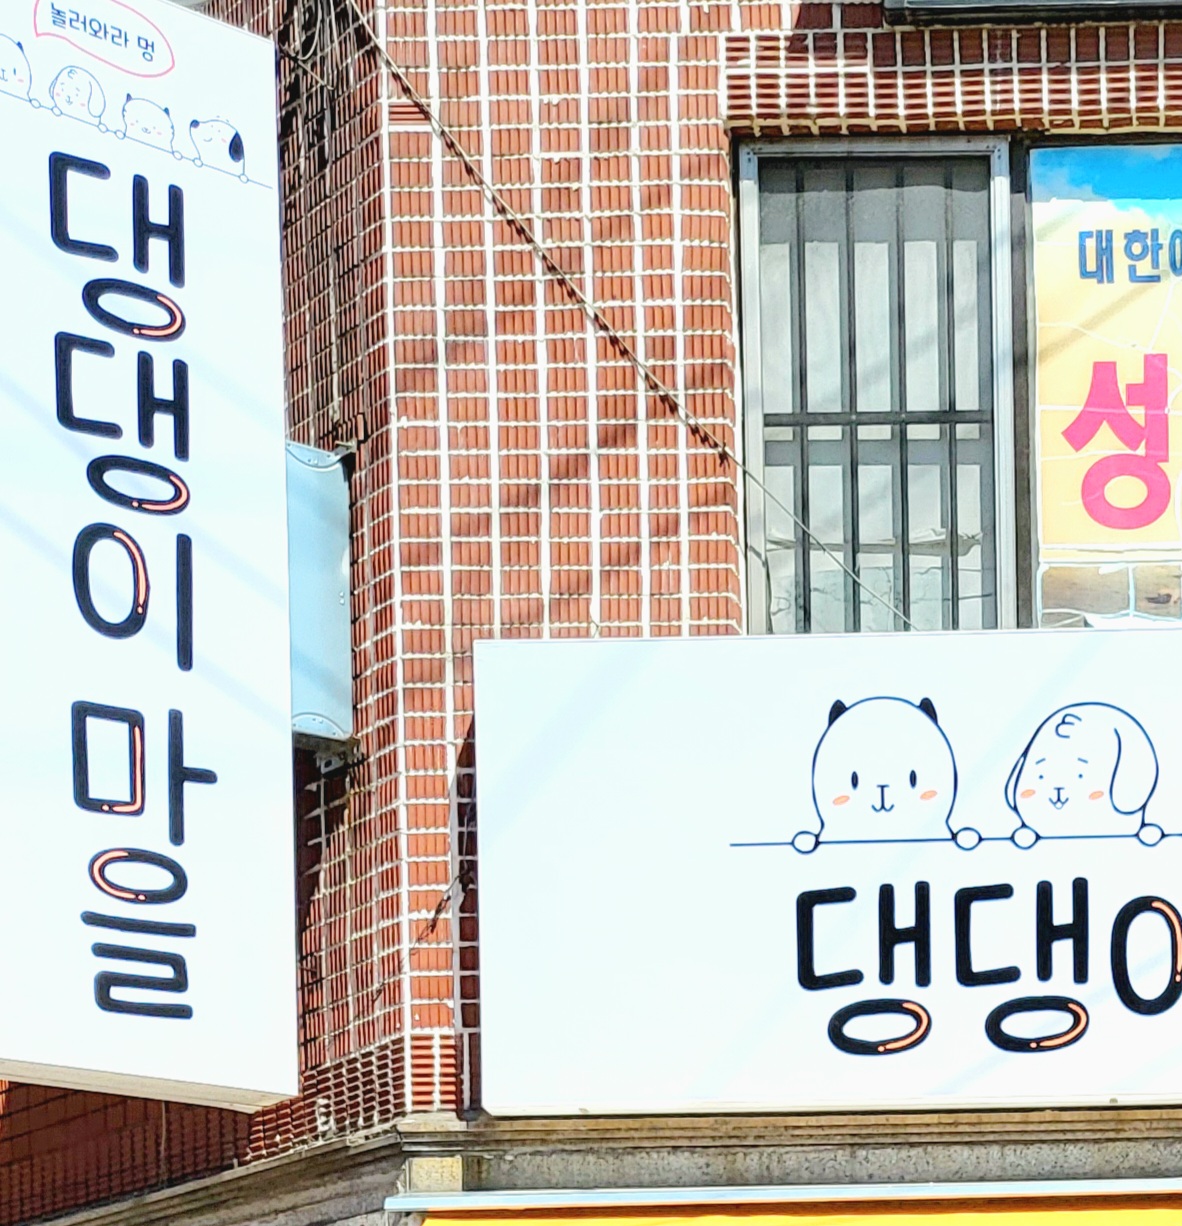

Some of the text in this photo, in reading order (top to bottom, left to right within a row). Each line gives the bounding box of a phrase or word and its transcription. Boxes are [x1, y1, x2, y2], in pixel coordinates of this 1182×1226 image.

[50, 1, 156, 62] 놀러와라 멍
[49, 151, 194, 672] 댕댕이
[71, 700, 218, 1020] 마을
